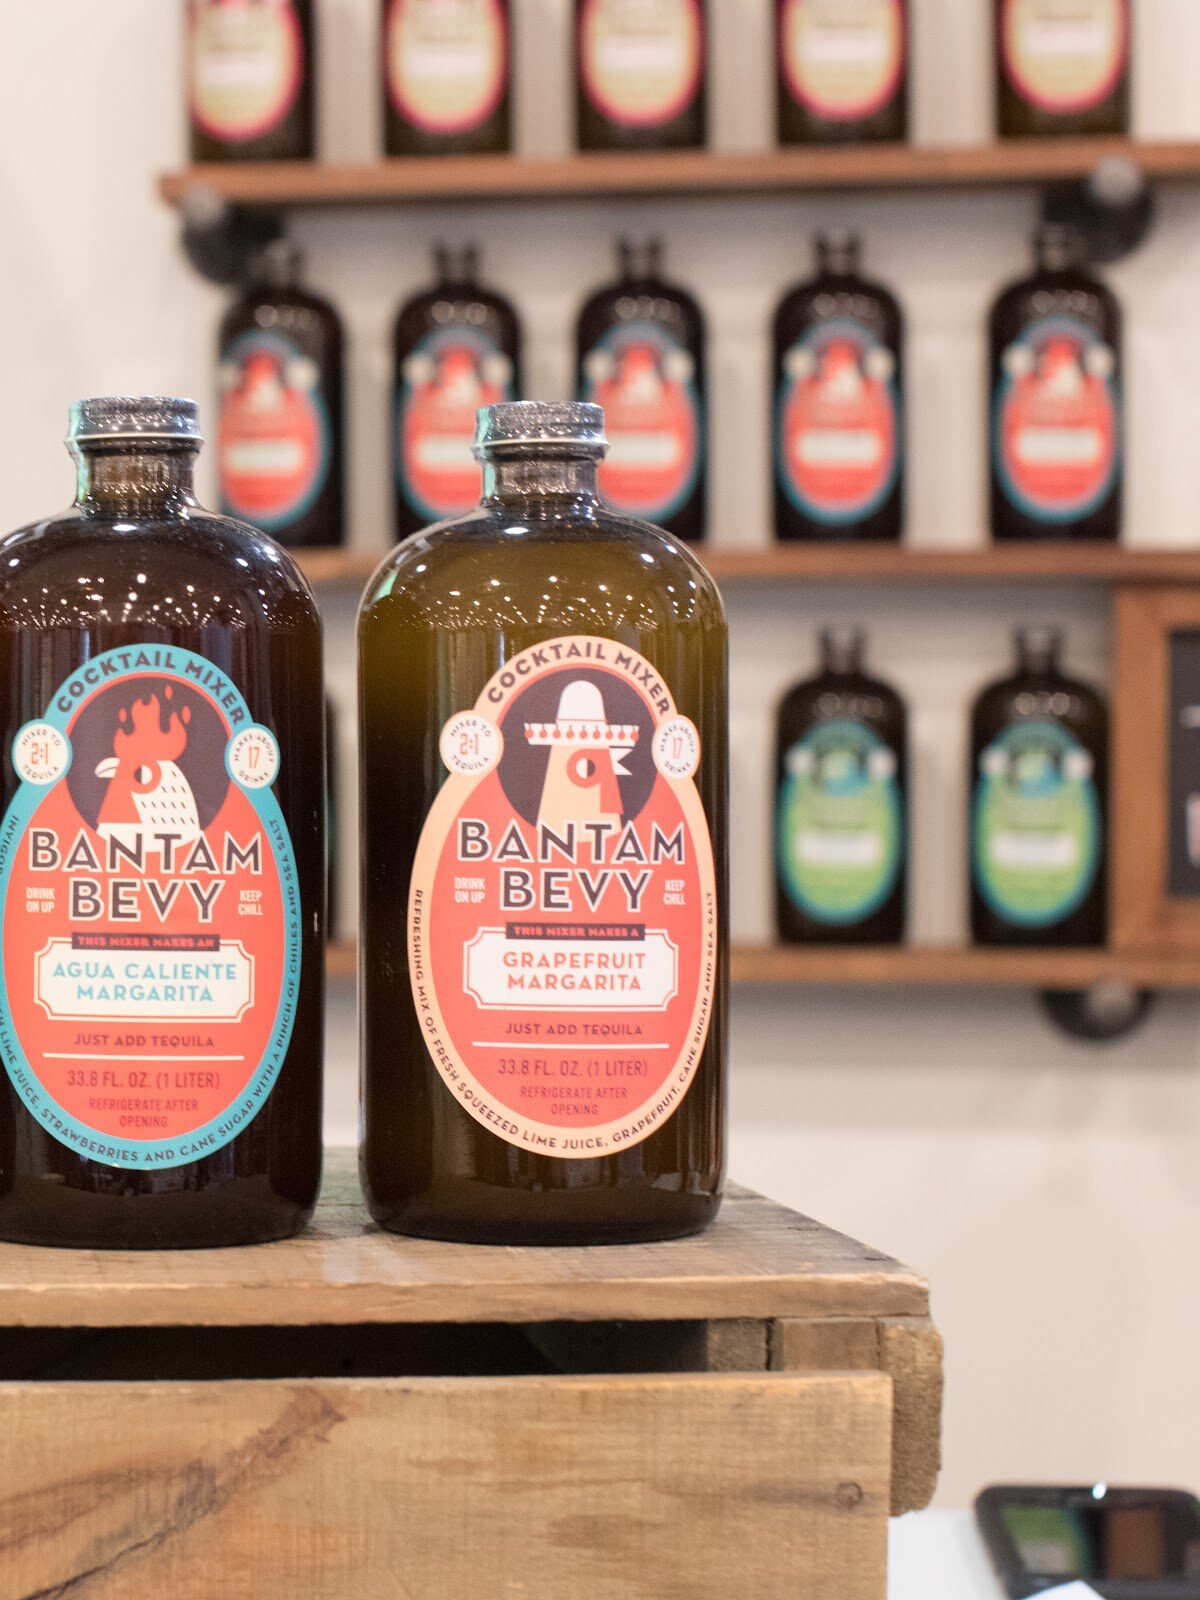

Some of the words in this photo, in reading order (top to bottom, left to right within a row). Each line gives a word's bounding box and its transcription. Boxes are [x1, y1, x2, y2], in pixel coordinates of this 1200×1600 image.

[56, 650, 176, 713] COCKTAIL
[184, 659, 245, 725] MIXER
[487, 641, 606, 704] COCKTAIL
[614, 651, 670, 717] MIXER
[31, 742, 48, 765] 2:1
[460, 733, 478, 755] 2:1
[673, 737, 683, 759] 17
[249, 746, 260, 768] 17
[31, 830, 261, 873] BANTAM
[459, 821, 683, 864] BANTAM
[25, 887, 55, 900] DRINK
[454, 877, 486, 890] DRINK
[503, 870, 651, 911] BEVY
[664, 879, 685, 892] KEEP
[71, 880, 224, 921] BEVY
[240, 889, 262, 902] KEEP
[287, 886, 297, 916] AND
[454, 890, 469, 903] ON
[470, 890, 485, 904] UP
[663, 892, 687, 905] CHILL
[26, 900, 39, 913] ON
[41, 900, 55, 914] UP
[238, 903, 264, 916] CHILL
[412, 889, 424, 981] REFRESHING
[513, 926, 543, 936] THIS
[546, 927, 585, 937] MIXER
[588, 927, 628, 937] MAKES
[631, 928, 639, 937] A
[290, 922, 298, 973] CHILES
[53, 961, 115, 979] AGUA
[124, 963, 237, 980] CALIENTE
[502, 951, 646, 969] GRAPEFRUIT
[507, 973, 641, 990] MARGARITA
[704, 962, 713, 993] AND
[76, 984, 213, 1001] MARGARITA
[287, 979, 295, 998] OF
[417, 985, 431, 1012] MIX
[276, 1002, 292, 1048] PINCH
[425, 1016, 438, 1036] OF
[505, 1023, 541, 1035] JUST
[547, 1024, 577, 1035] ADD
[582, 1024, 642, 1036] TEQUILA
[693, 998, 709, 1044] SUGAR
[0, 1030, 17, 1065] LIME
[74, 1033, 109, 1046] JUST
[114, 1035, 146, 1047] ADD
[152, 1035, 215, 1048] TEQUILA
[272, 1052, 280, 1062] A
[433, 1038, 460, 1081] FRESH
[678, 1046, 698, 1083] CANE
[498, 1059, 530, 1075] 33.8
[534, 1060, 555, 1076] FL.
[560, 1060, 583, 1076] OZ.
[587, 1060, 599, 1078] (1
[605, 1060, 648, 1078] LITER)
[12, 1067, 39, 1110] JUICE,
[67, 1070, 98, 1087] 33.8
[102, 1071, 124, 1088] FL.
[128, 1072, 152, 1088] OZ.
[156, 1072, 169, 1090] (1
[175, 1072, 220, 1090] LITER)
[253, 1063, 275, 1098] WITH
[520, 1086, 592, 1099] REFRIGERATE
[595, 1087, 628, 1099] AFTER
[89, 1097, 160, 1111] REFRIGERATE
[165, 1099, 198, 1112] AFTER
[457, 1082, 519, 1136] SQUEEZED
[551, 1103, 598, 1116] OPENING
[612, 1085, 681, 1143] GRAPEFRUIT,
[119, 1115, 168, 1128] OPENING
[218, 1099, 254, 1137] SUGAR
[41, 1108, 139, 1162] STRAWBERRIES
[179, 1133, 217, 1156] CANE
[522, 1130, 557, 1148] LIME
[562, 1137, 609, 1150] JUICE,
[144, 1149, 175, 1163] AND
